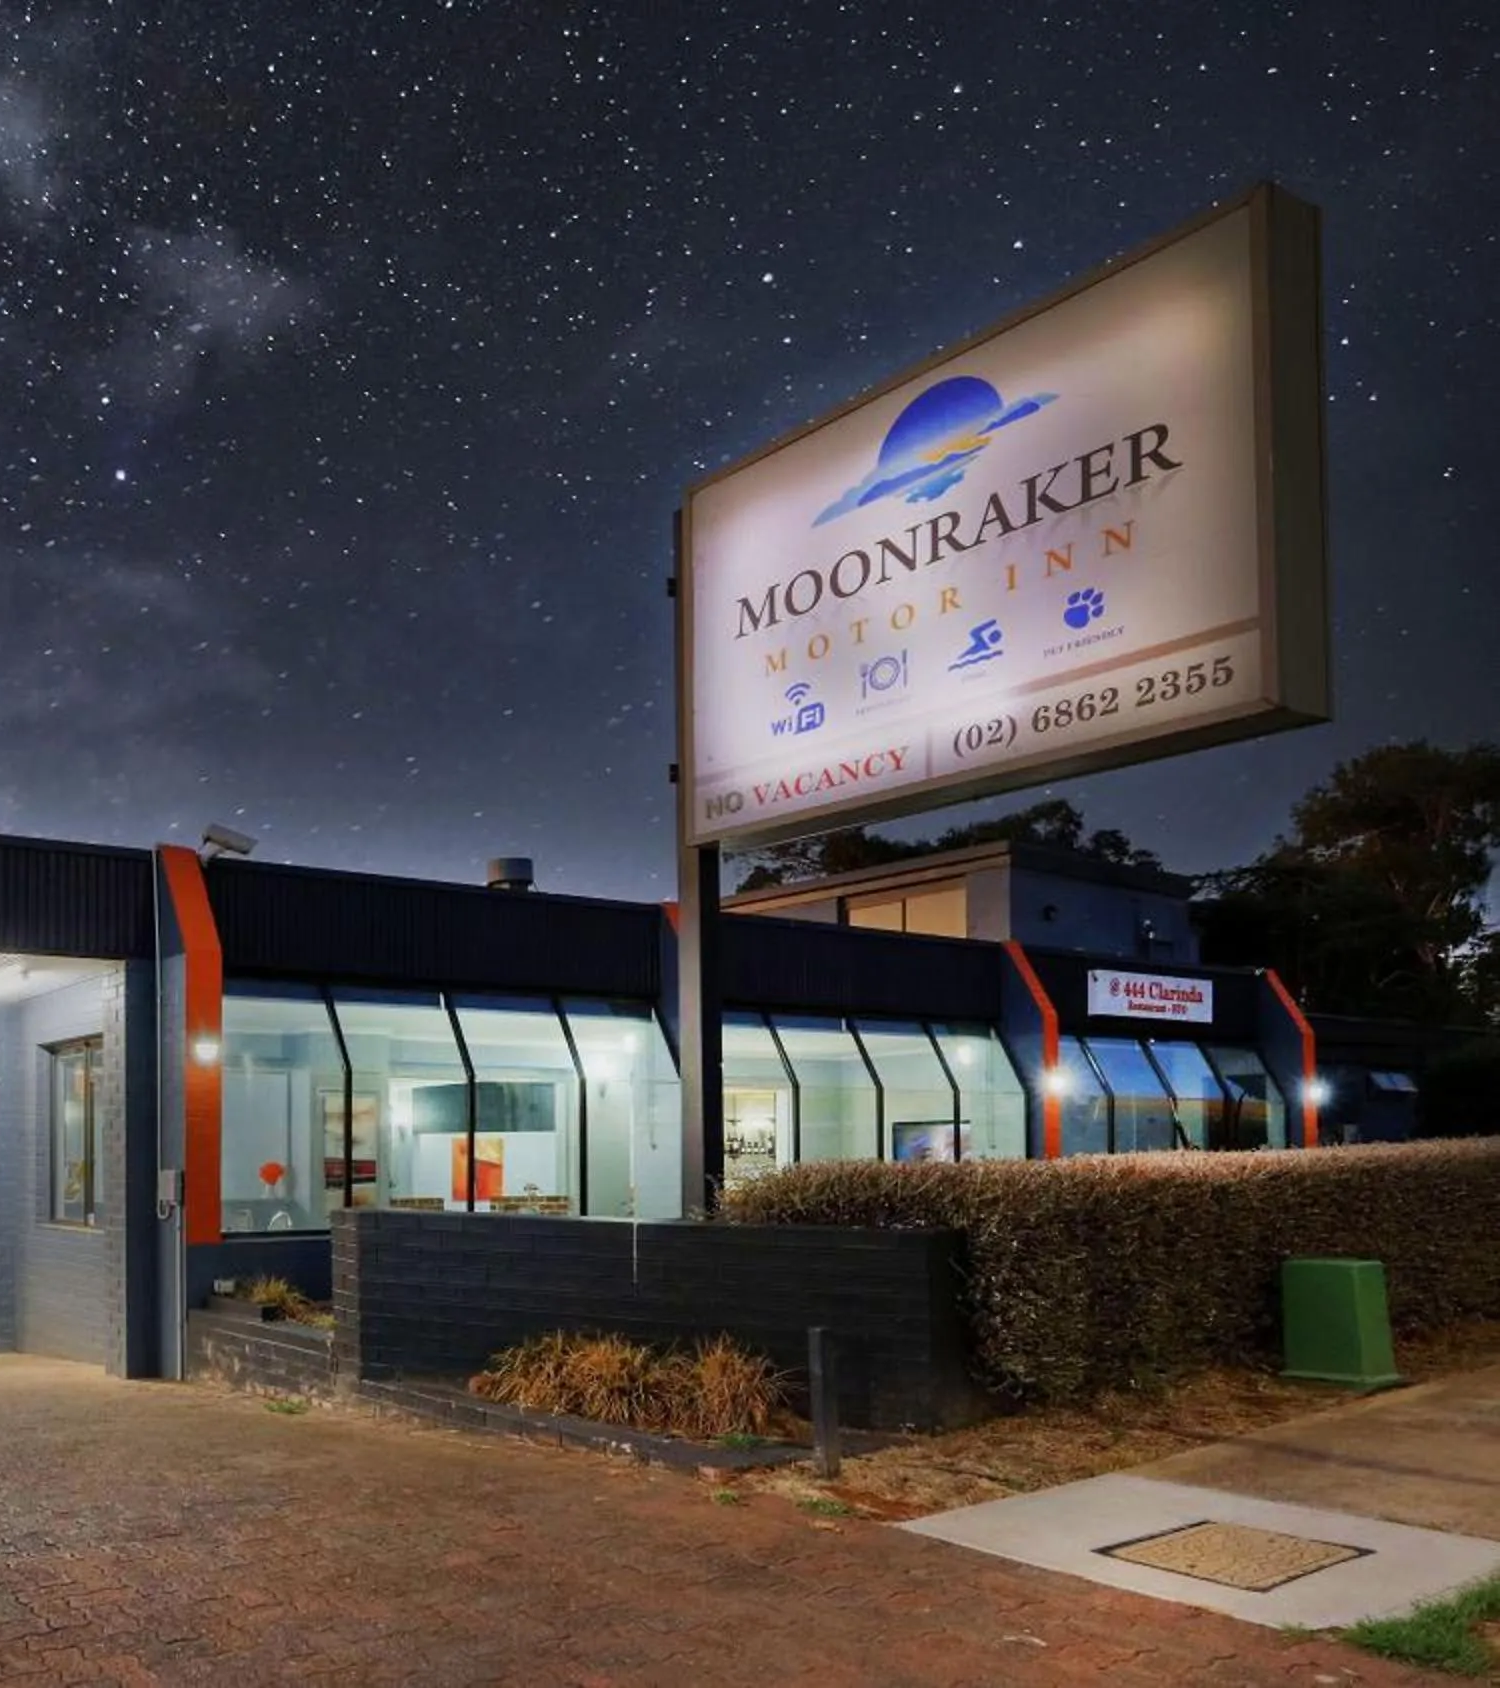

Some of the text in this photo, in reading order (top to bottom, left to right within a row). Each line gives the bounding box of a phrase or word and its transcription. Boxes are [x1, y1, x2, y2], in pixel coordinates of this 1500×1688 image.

[734, 423, 1183, 640] MOONRAKER
[763, 520, 1137, 677] MOTOR INN
[953, 655, 1235, 758] (02) 6862 2355
[706, 746, 910, 820] NO VACANCY
[1124, 981, 1145, 998] 444
[1150, 981, 1204, 1003] Clarinda
